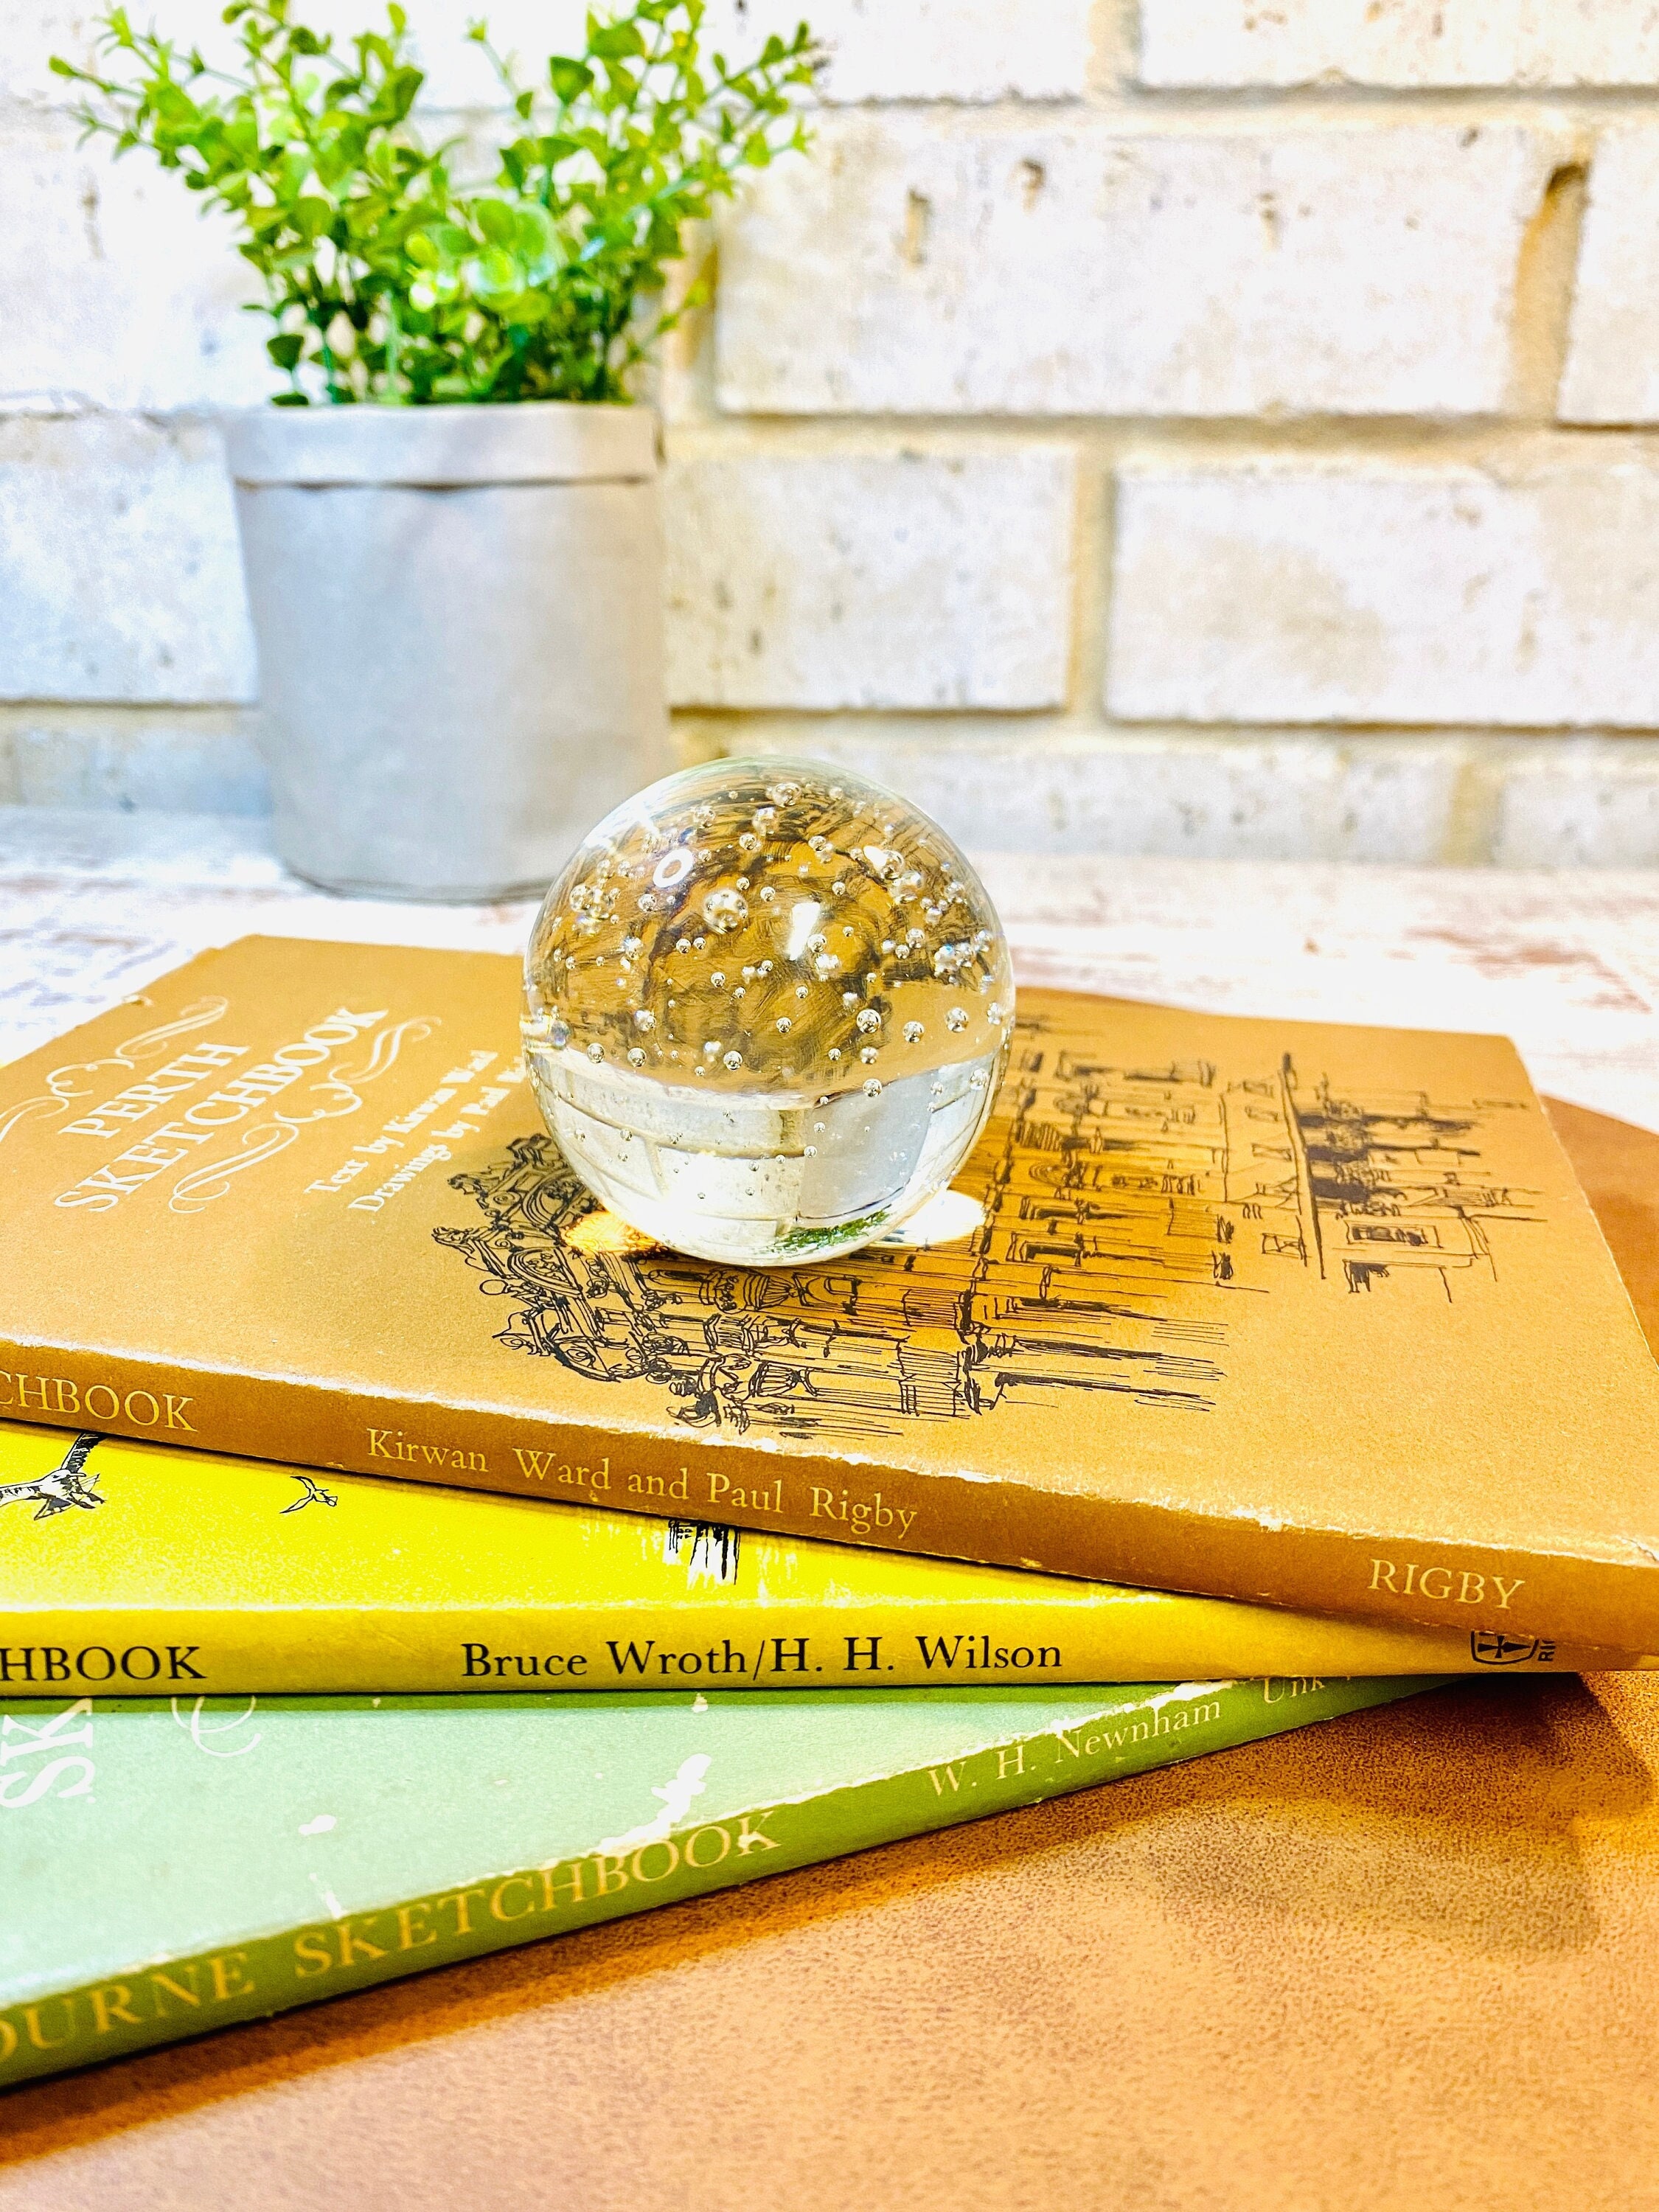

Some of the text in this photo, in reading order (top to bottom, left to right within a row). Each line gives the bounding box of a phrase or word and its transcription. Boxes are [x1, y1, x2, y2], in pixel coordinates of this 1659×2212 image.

[55, 1007, 389, 1212] SKETCHBOOK
[58, 1042, 251, 1139] PERTH
[303, 1158, 369, 1193] Text
[353, 1135, 404, 1155] by
[382, 1088, 457, 1134] Kirwan
[348, 1144, 452, 1212] Drawings
[431, 1120, 480, 1138] by
[366, 1427, 489, 1472] Kirwan
[512, 1447, 613, 1492] Ward
[627, 1467, 689, 1502] and
[706, 1472, 783, 1514] Paul
[809, 1486, 918, 1539] Rigby
[1367, 1558, 1526, 1610] RIGBY
[460, 1643, 588, 1678] Bruce
[606, 1637, 823, 1682] Wroth/H.
[844, 1636, 894, 1672] H.
[915, 1635, 1062, 1669] Wilson
[293, 1809, 782, 1979] SKETCHBOOK
[928, 1761, 978, 1797] W.
[995, 1744, 1037, 1780] H.
[1055, 1700, 1222, 1764] Newnham
